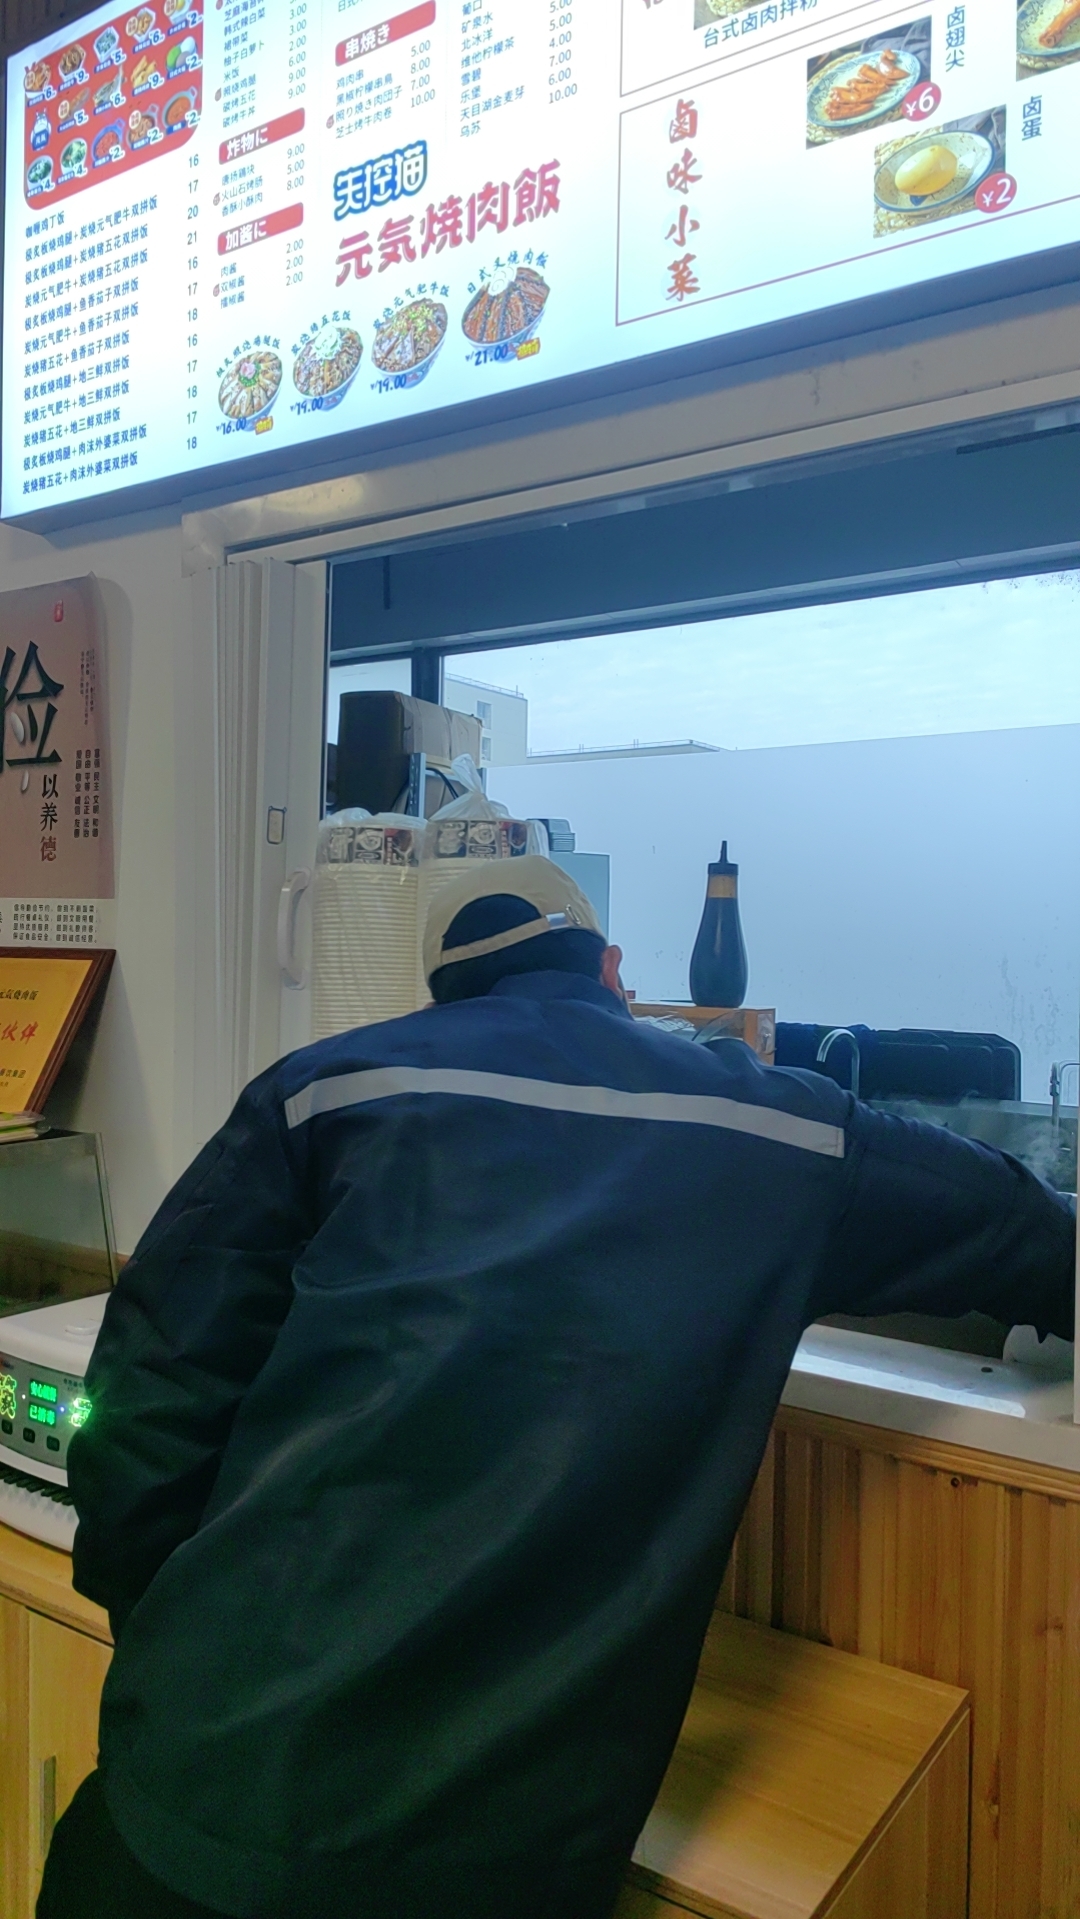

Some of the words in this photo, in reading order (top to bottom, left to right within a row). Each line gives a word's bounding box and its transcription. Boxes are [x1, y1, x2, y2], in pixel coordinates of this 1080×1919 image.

[290, 3, 307, 19] 3.00
[289, 19, 306, 36] 3.00
[461, 11, 493, 34] 矿泉水
[549, 12, 572, 31] 5.00
[289, 35, 306, 52] 2.00
[461, 28, 492, 52] 北冰洋
[549, 30, 572, 48] 4.00
[945, 5, 966, 73] 卤翅尖
[411, 40, 431, 57] 5.00
[461, 36, 514, 69] 维他柠檬茶
[289, 51, 306, 67] 6.00
[411, 57, 430, 74] 8.00
[549, 49, 571, 67] 7.00
[223, 66, 239, 83] 米饭
[289, 67, 306, 83] 9.00
[410, 74, 430, 91] 7.00
[548, 67, 571, 86] 6.00
[288, 83, 306, 99] 9.00
[411, 88, 435, 108] 10.00
[549, 83, 577, 104] 10.00
[905, 91, 934, 116] ¥6
[1021, 95, 1043, 142] 卤蛋
[460, 120, 480, 137] 乌苏
[226, 127, 268, 160] 炸物に
[286, 143, 304, 159] 9.00
[189, 154, 199, 168] 16
[286, 159, 304, 175] 5.00
[188, 180, 198, 194] 17
[286, 175, 304, 191] 8.00
[664, 98, 702, 302] 卤味小菜
[981, 177, 1012, 208] ¥2
[187, 205, 198, 220] 20
[187, 231, 197, 245] 21
[286, 239, 304, 254] 2.00
[188, 256, 198, 271] 16
[286, 255, 303, 270] 2.00
[285, 271, 303, 286] 2.00
[188, 282, 197, 296] 17
[187, 308, 198, 322] 18
[187, 333, 197, 347] 16
[187, 359, 197, 373] 17
[187, 385, 197, 399] 18
[187, 411, 197, 424] 17
[187, 436, 197, 450] 18
[40, 774, 58, 862] 以养德
